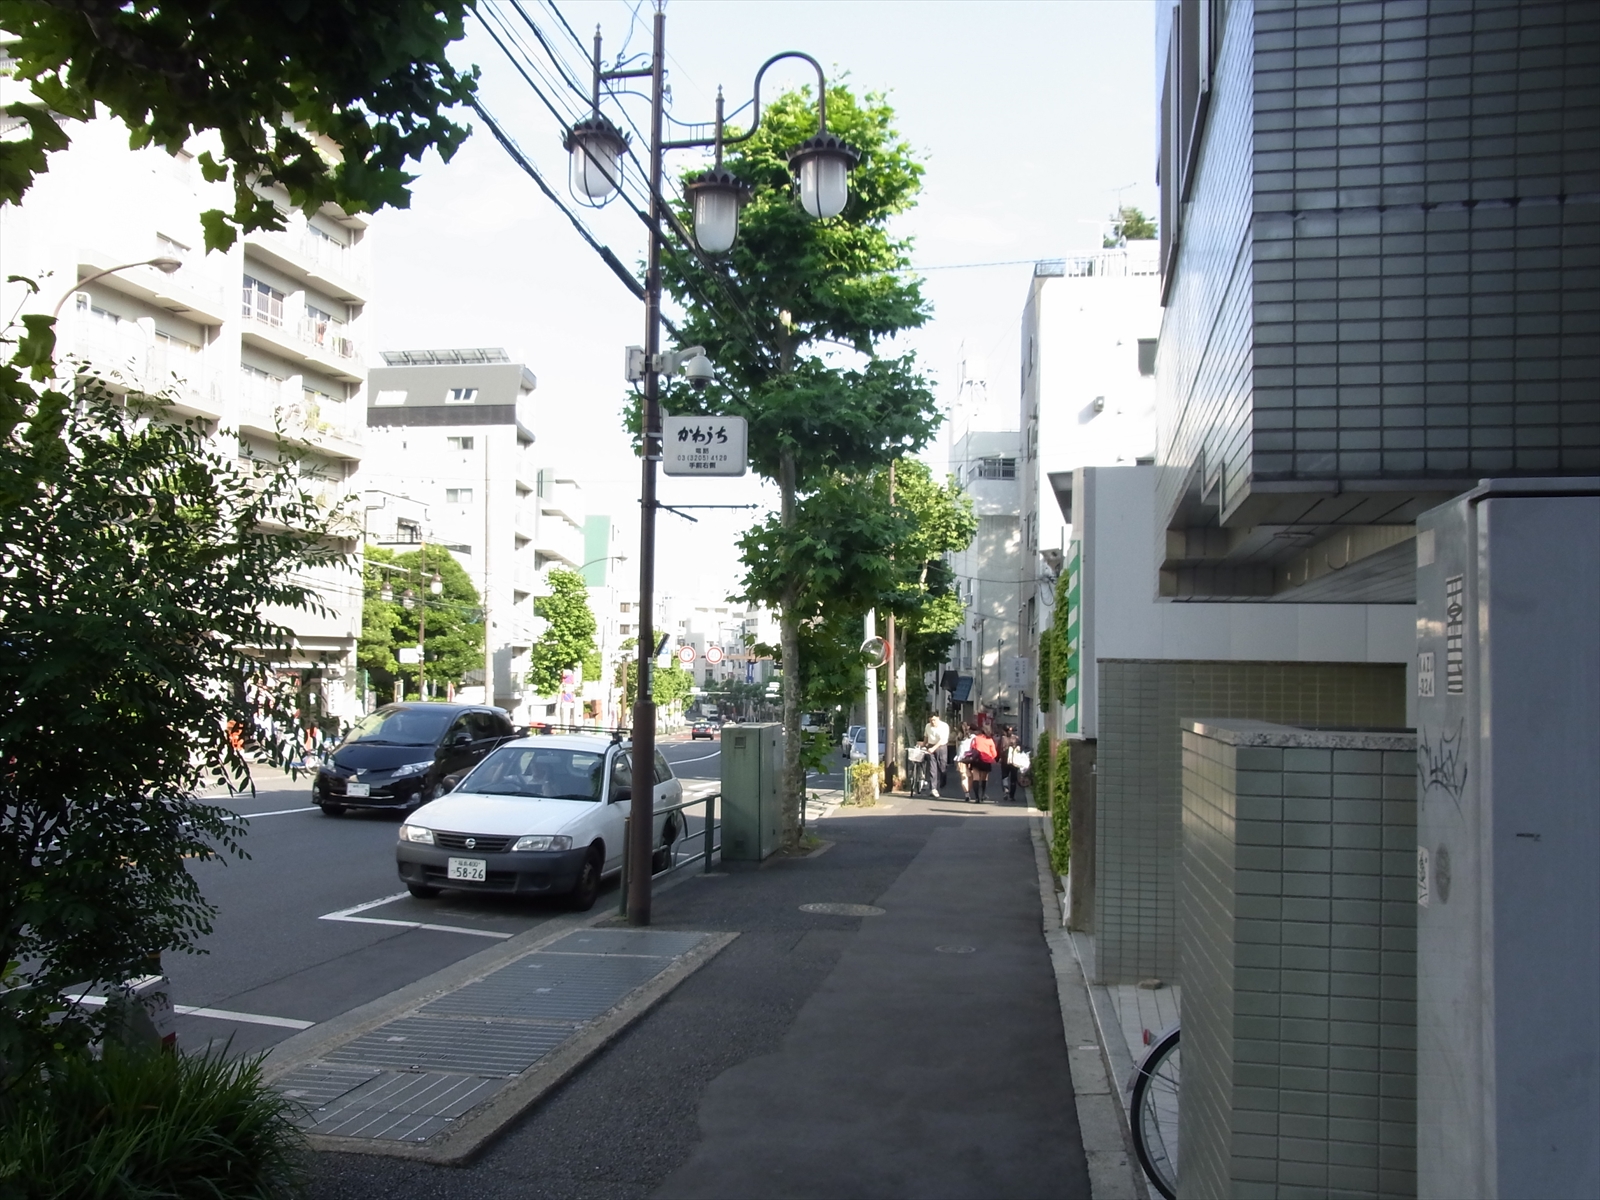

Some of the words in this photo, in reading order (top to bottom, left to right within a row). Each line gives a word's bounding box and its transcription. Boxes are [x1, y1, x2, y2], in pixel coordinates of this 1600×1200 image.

[677, 425, 728, 446] かわうち
[456, 866, 484, 880] 58-26
